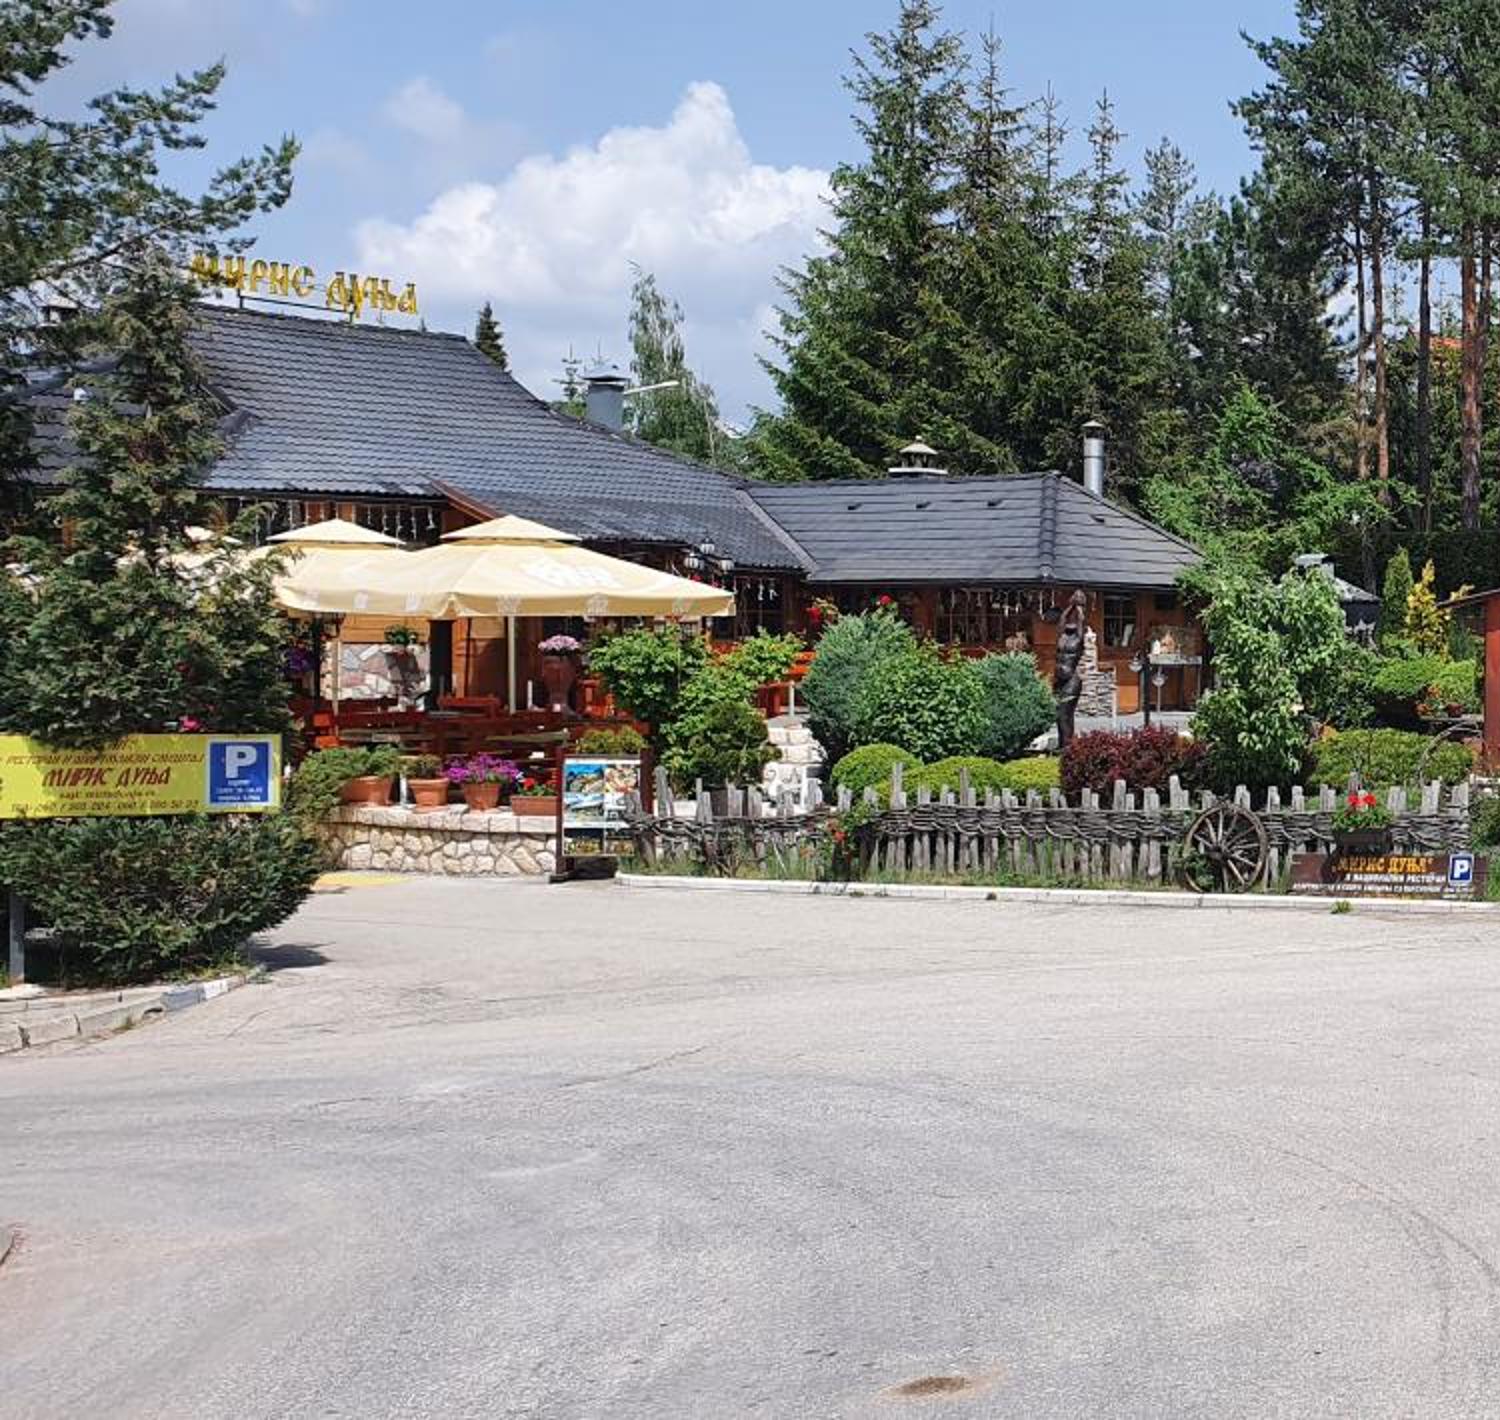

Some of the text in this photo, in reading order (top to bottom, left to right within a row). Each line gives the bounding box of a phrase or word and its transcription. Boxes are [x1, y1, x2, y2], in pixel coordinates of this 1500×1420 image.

[326, 271, 418, 319] ДУЊА
[225, 745, 258, 779] P
[42, 765, 172, 789] МИРИС ДУЊА
[1453, 859, 1471, 880] P
